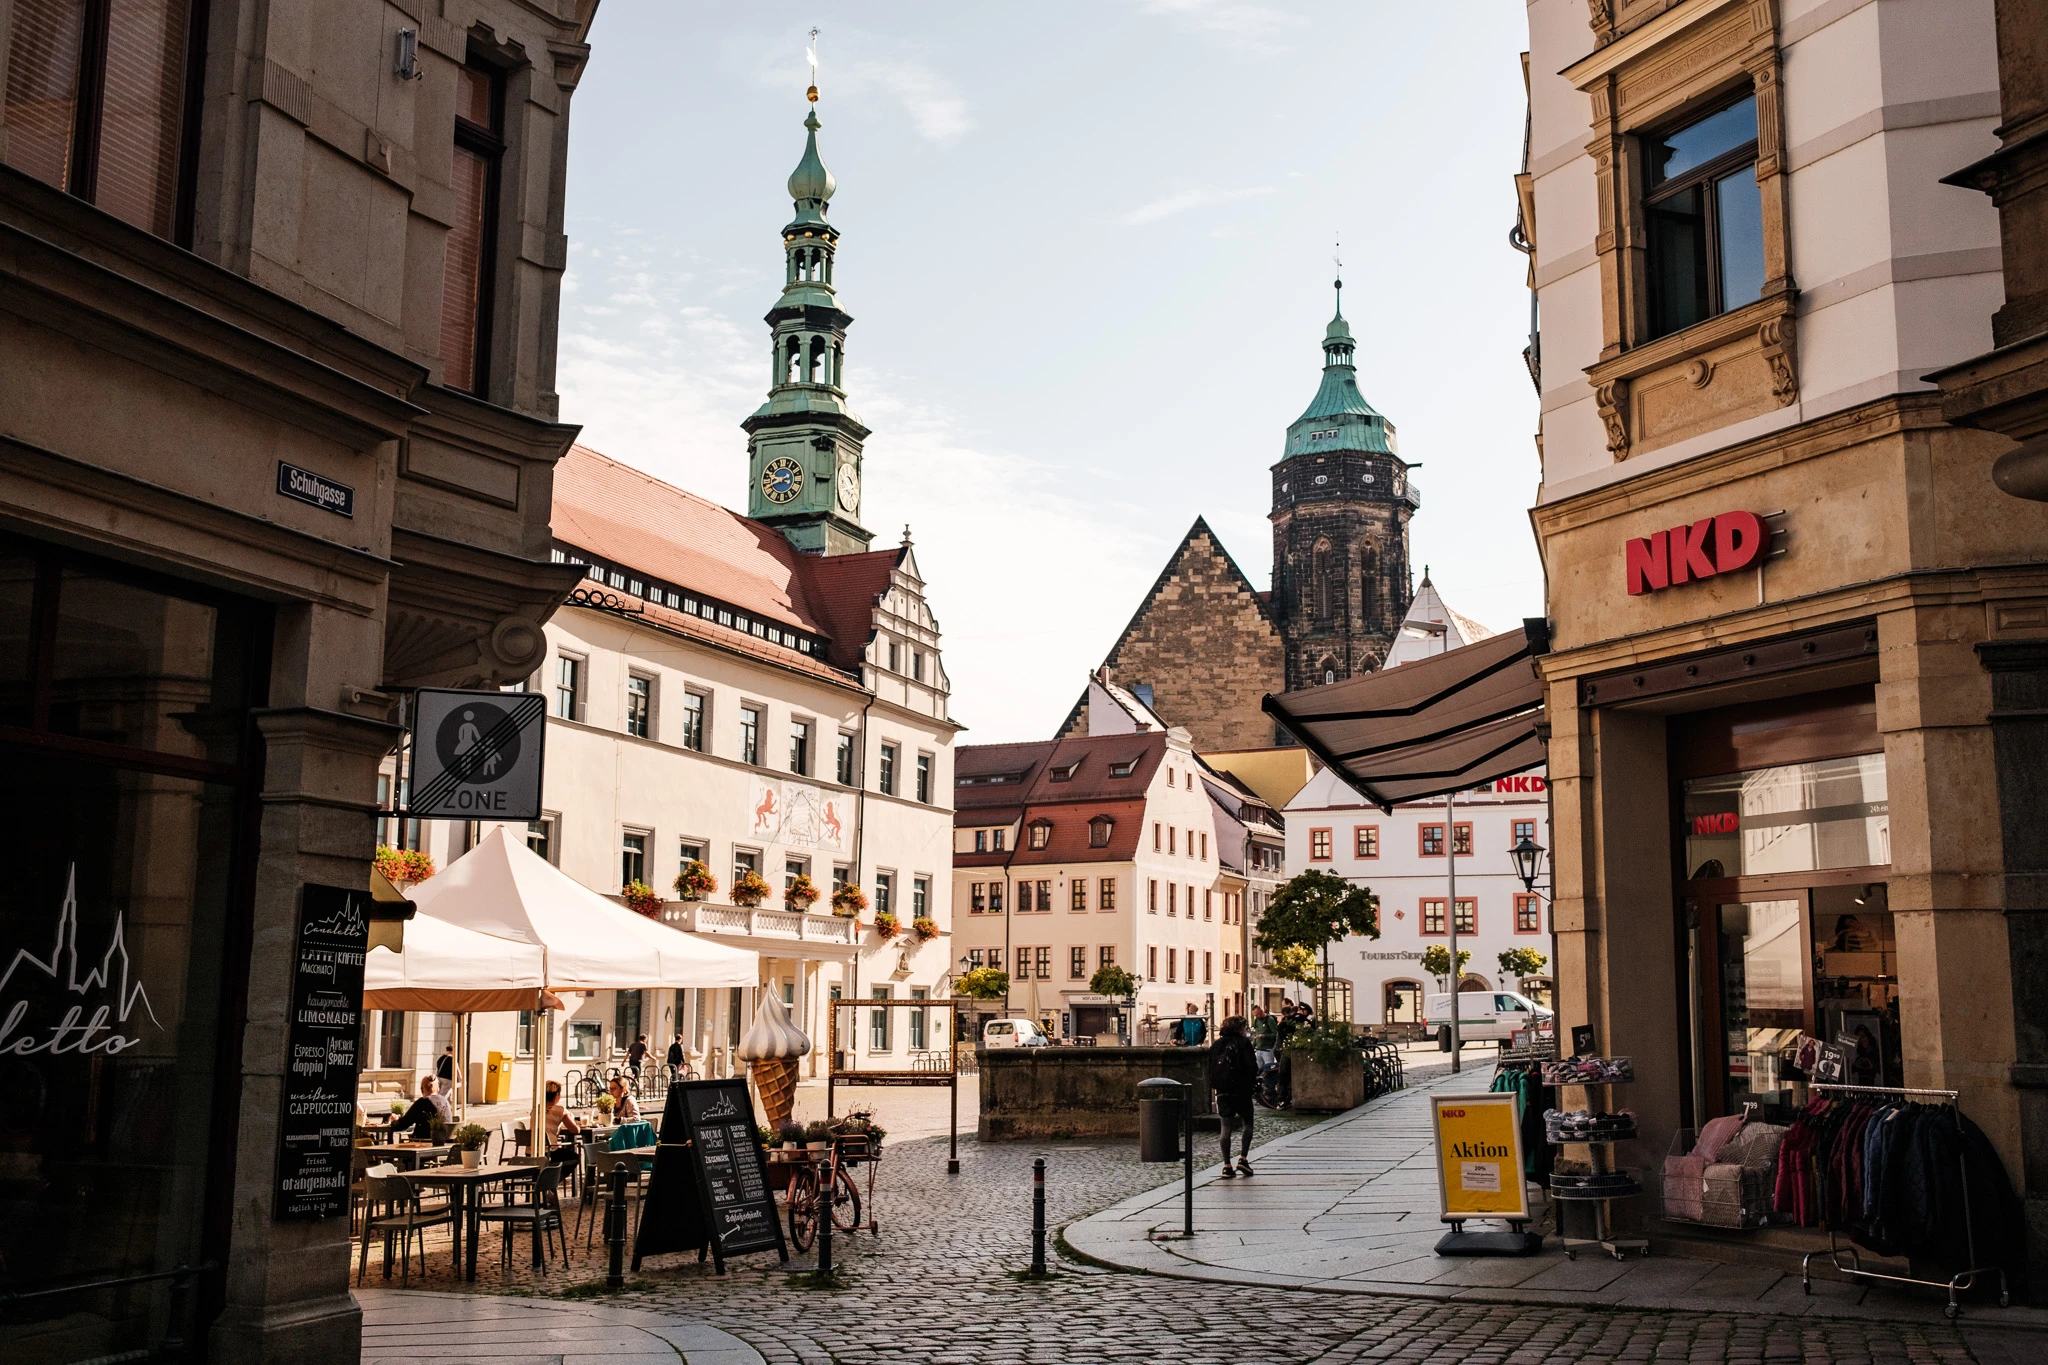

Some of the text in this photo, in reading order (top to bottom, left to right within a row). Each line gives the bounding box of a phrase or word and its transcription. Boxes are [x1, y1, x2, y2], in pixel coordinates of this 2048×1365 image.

[290, 469, 346, 507] Schuhgasse
[1626, 510, 1768, 596] NKD
[1496, 776, 1546, 793] NKD
[442, 789, 508, 811] ZONE
[1693, 811, 1739, 836] NKD
[303, 922, 363, 938] Canaletto
[301, 948, 335, 963] LATTE
[337, 951, 365, 967] KAFFEE
[298, 1009, 356, 1025] LIMONADE
[294, 1043, 325, 1058] ESPRESSO
[328, 1052, 354, 1066] SPRITZ
[292, 1058, 324, 1077] doppio
[290, 1086, 338, 1101] weißen
[289, 1102, 352, 1115] CAPPUCCINO
[1442, 1109, 1466, 1119] NKD
[1450, 1141, 1509, 1158] Aktion
[306, 1157, 327, 1165] frisch
[298, 1165, 333, 1176] gepresster
[288, 1203, 312, 1213] täglich
